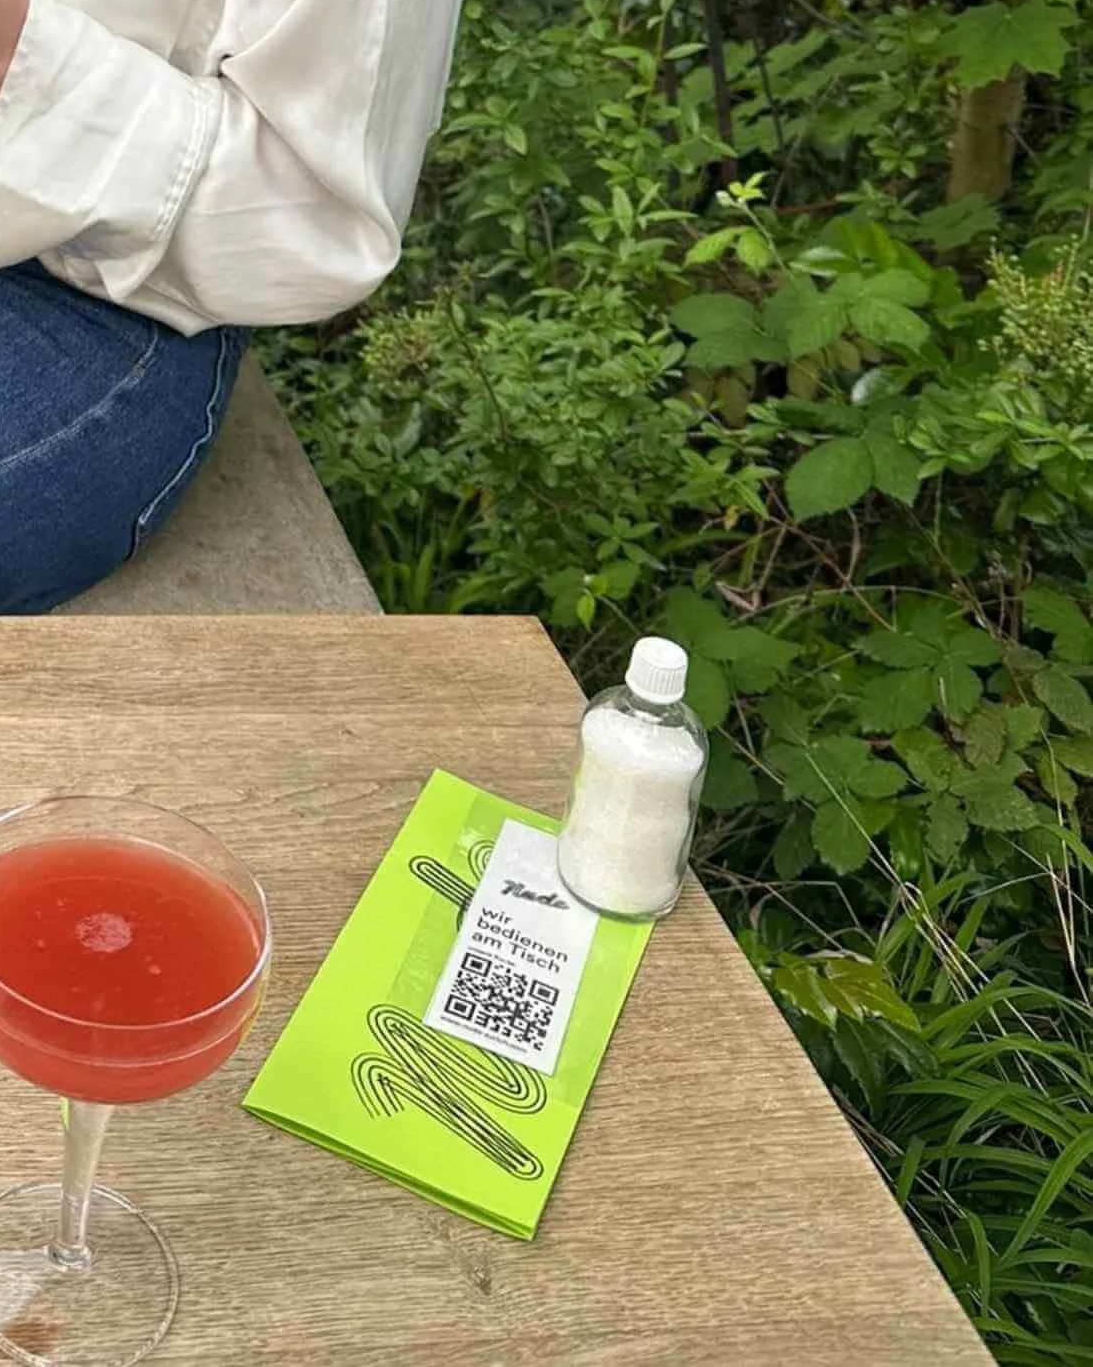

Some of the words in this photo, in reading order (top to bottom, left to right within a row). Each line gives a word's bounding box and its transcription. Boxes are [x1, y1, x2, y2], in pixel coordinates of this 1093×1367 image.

[482, 907, 512, 925] wir
[472, 932, 502, 949] am
[509, 940, 560, 973] Tisch
[477, 916, 568, 962] bedienen
